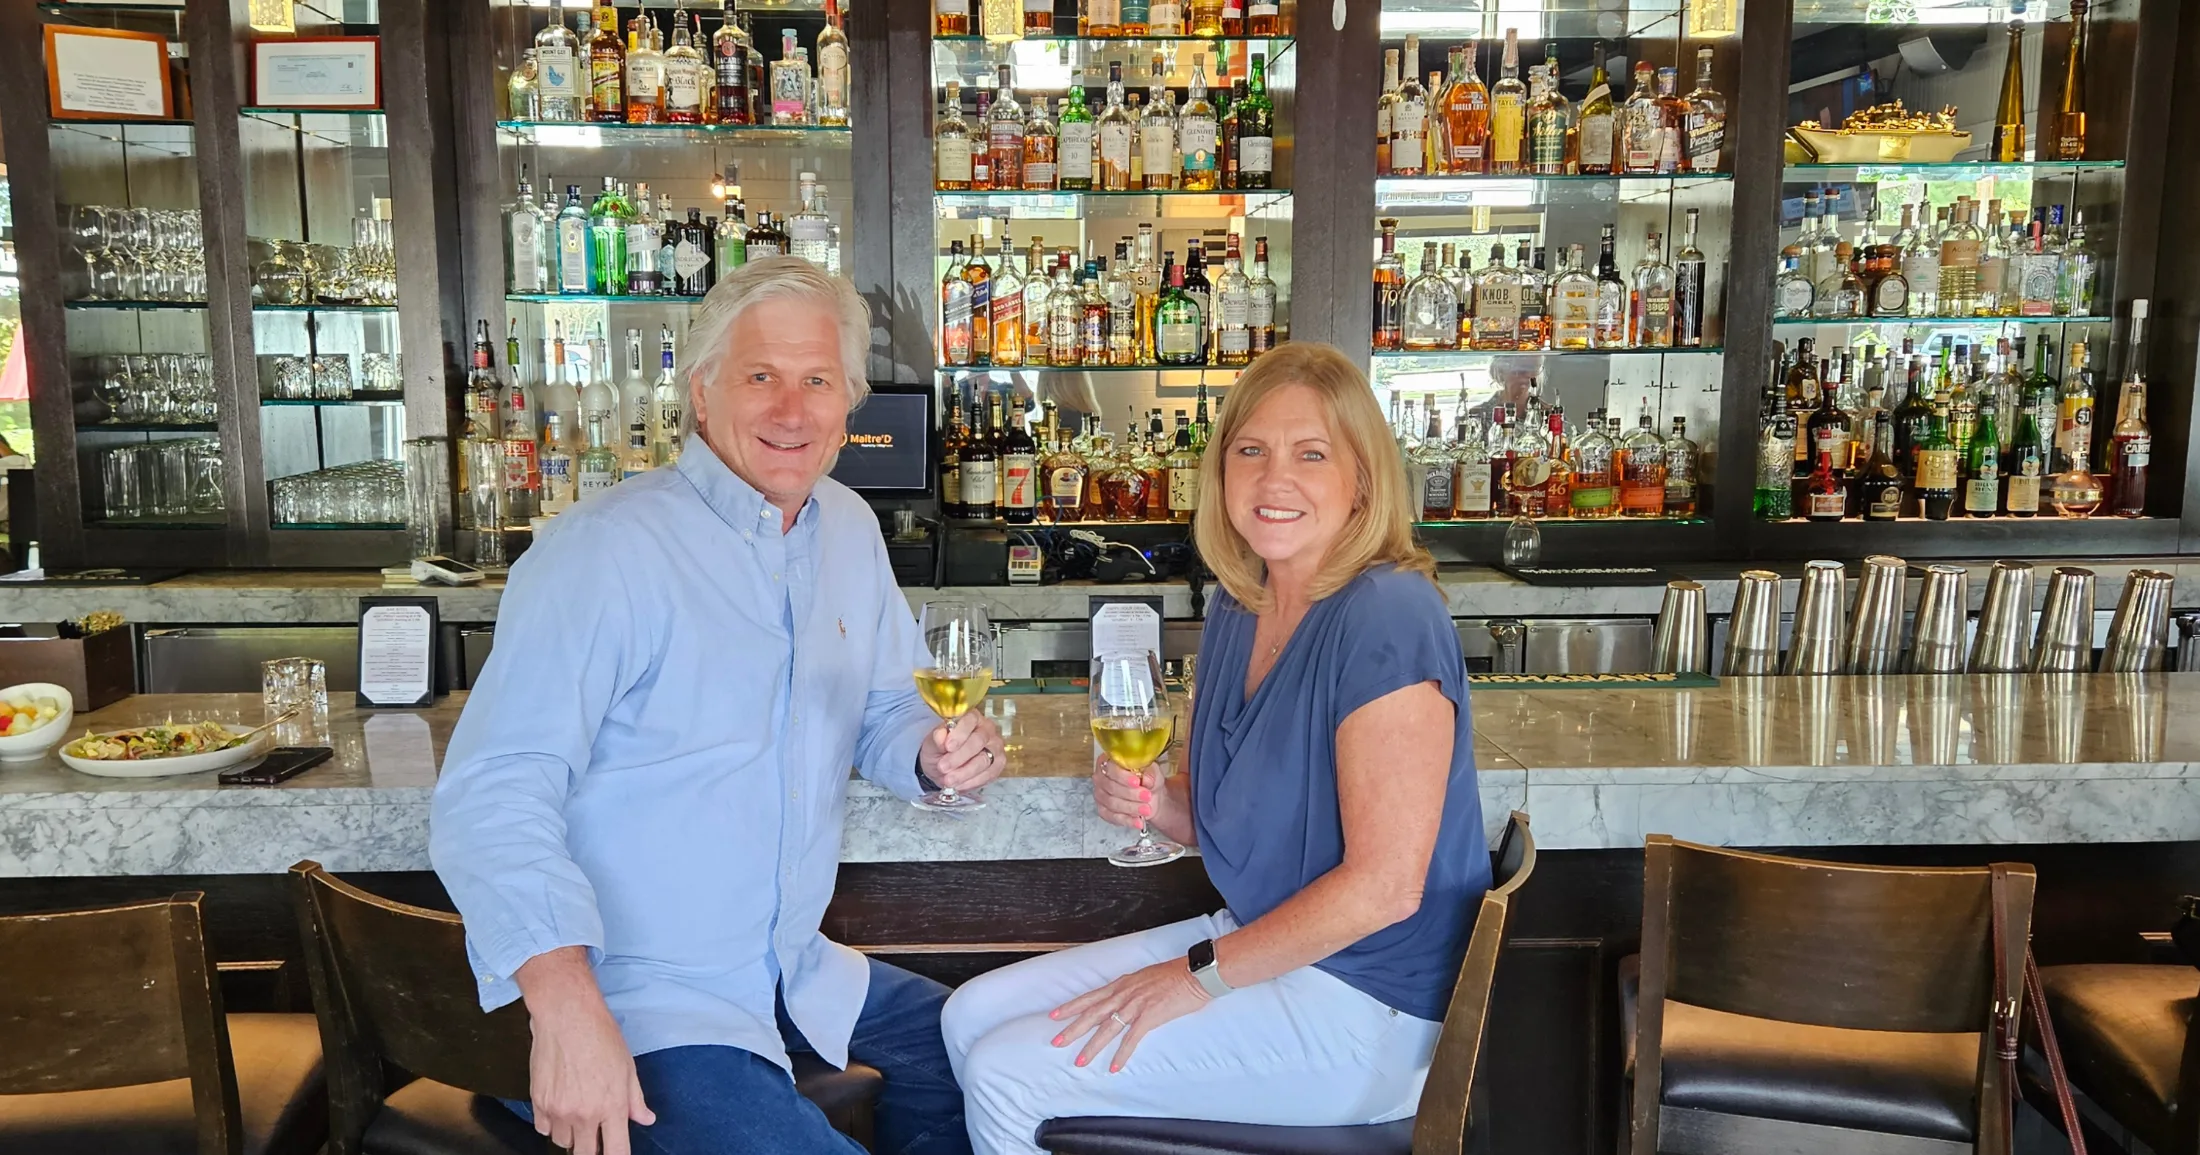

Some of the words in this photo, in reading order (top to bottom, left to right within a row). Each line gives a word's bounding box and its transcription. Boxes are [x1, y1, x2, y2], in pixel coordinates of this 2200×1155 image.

[1482, 288, 1509, 300] KNOB
[993, 304, 1004, 312] RED
[1004, 298, 1021, 307] LABEL
[1511, 304, 1517, 313] 9
[1014, 414, 1022, 425] 7
[2078, 411, 2090, 422] 51
[504, 444, 529, 452] STOLI
[1007, 467, 1030, 504] 7
[1548, 485, 1566, 495] 46
